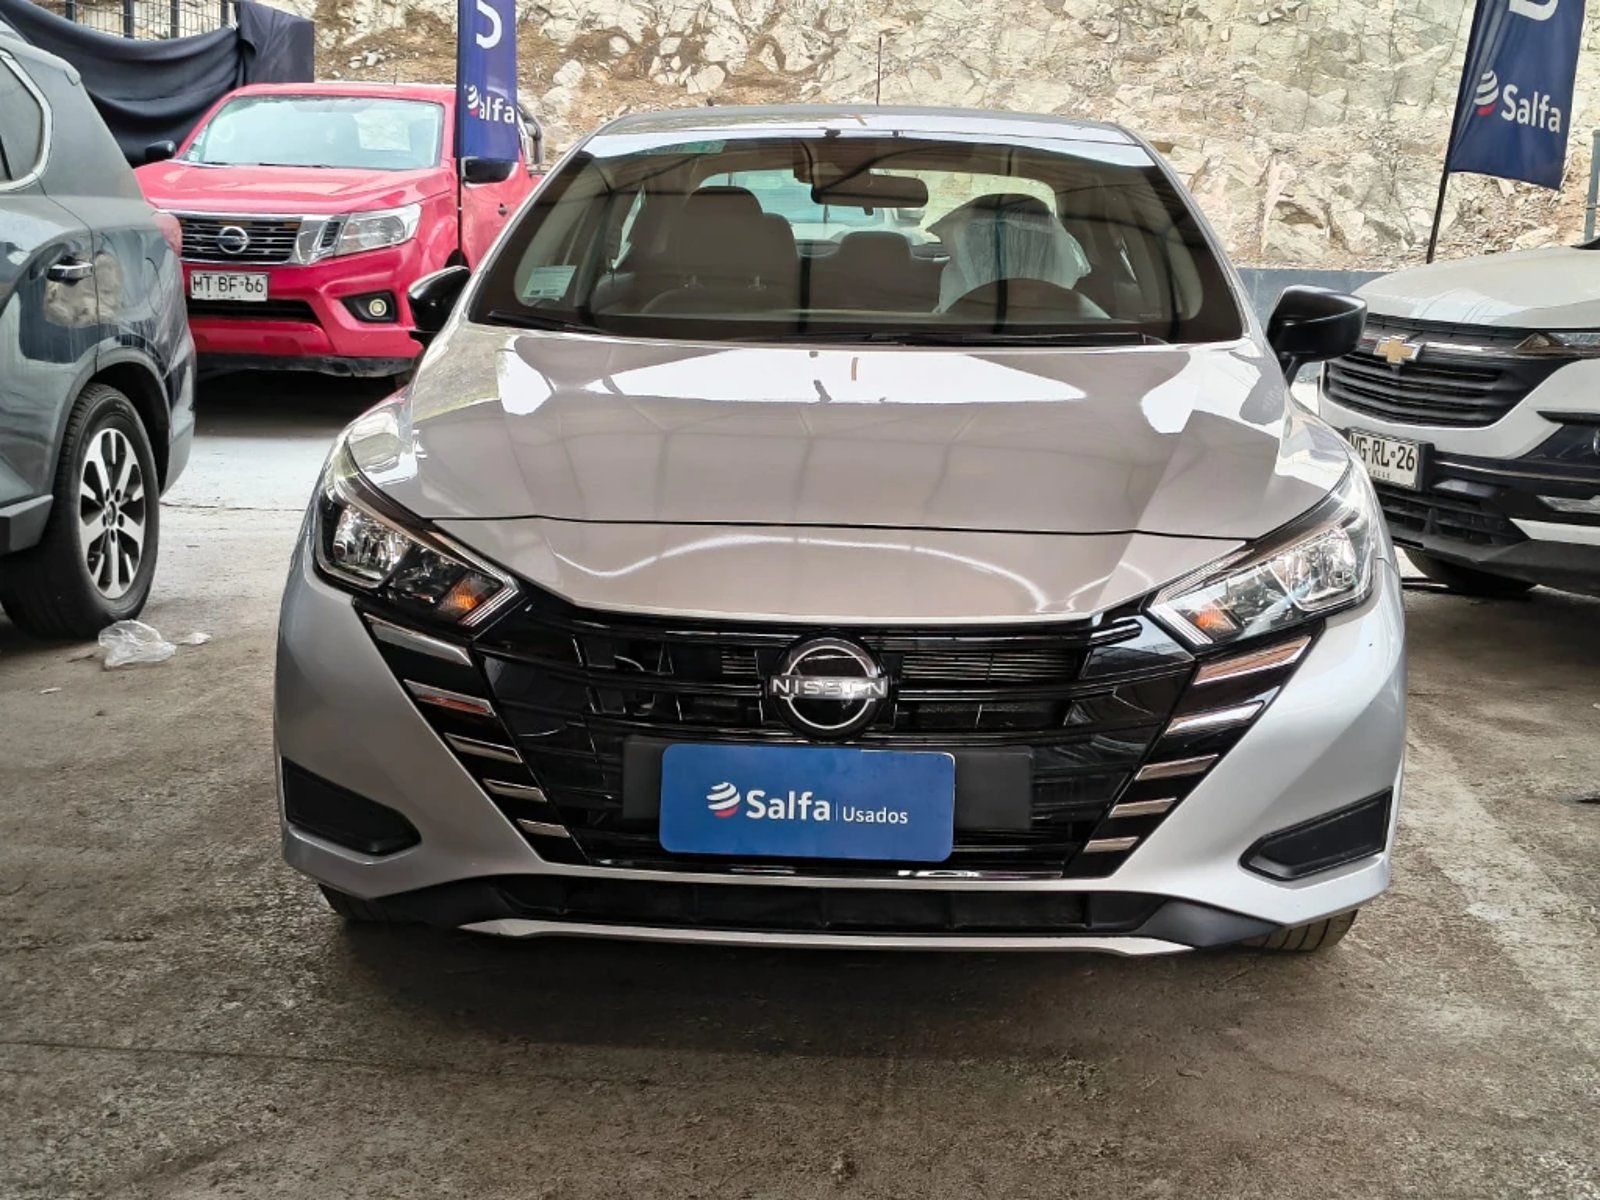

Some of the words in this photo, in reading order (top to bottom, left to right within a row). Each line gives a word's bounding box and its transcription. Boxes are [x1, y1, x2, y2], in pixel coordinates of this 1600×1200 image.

[479, 92, 516, 124] alfa
[1500, 83, 1562, 133] Salfa
[745, 789, 831, 821] Salfa
[843, 806, 909, 825] Usados
